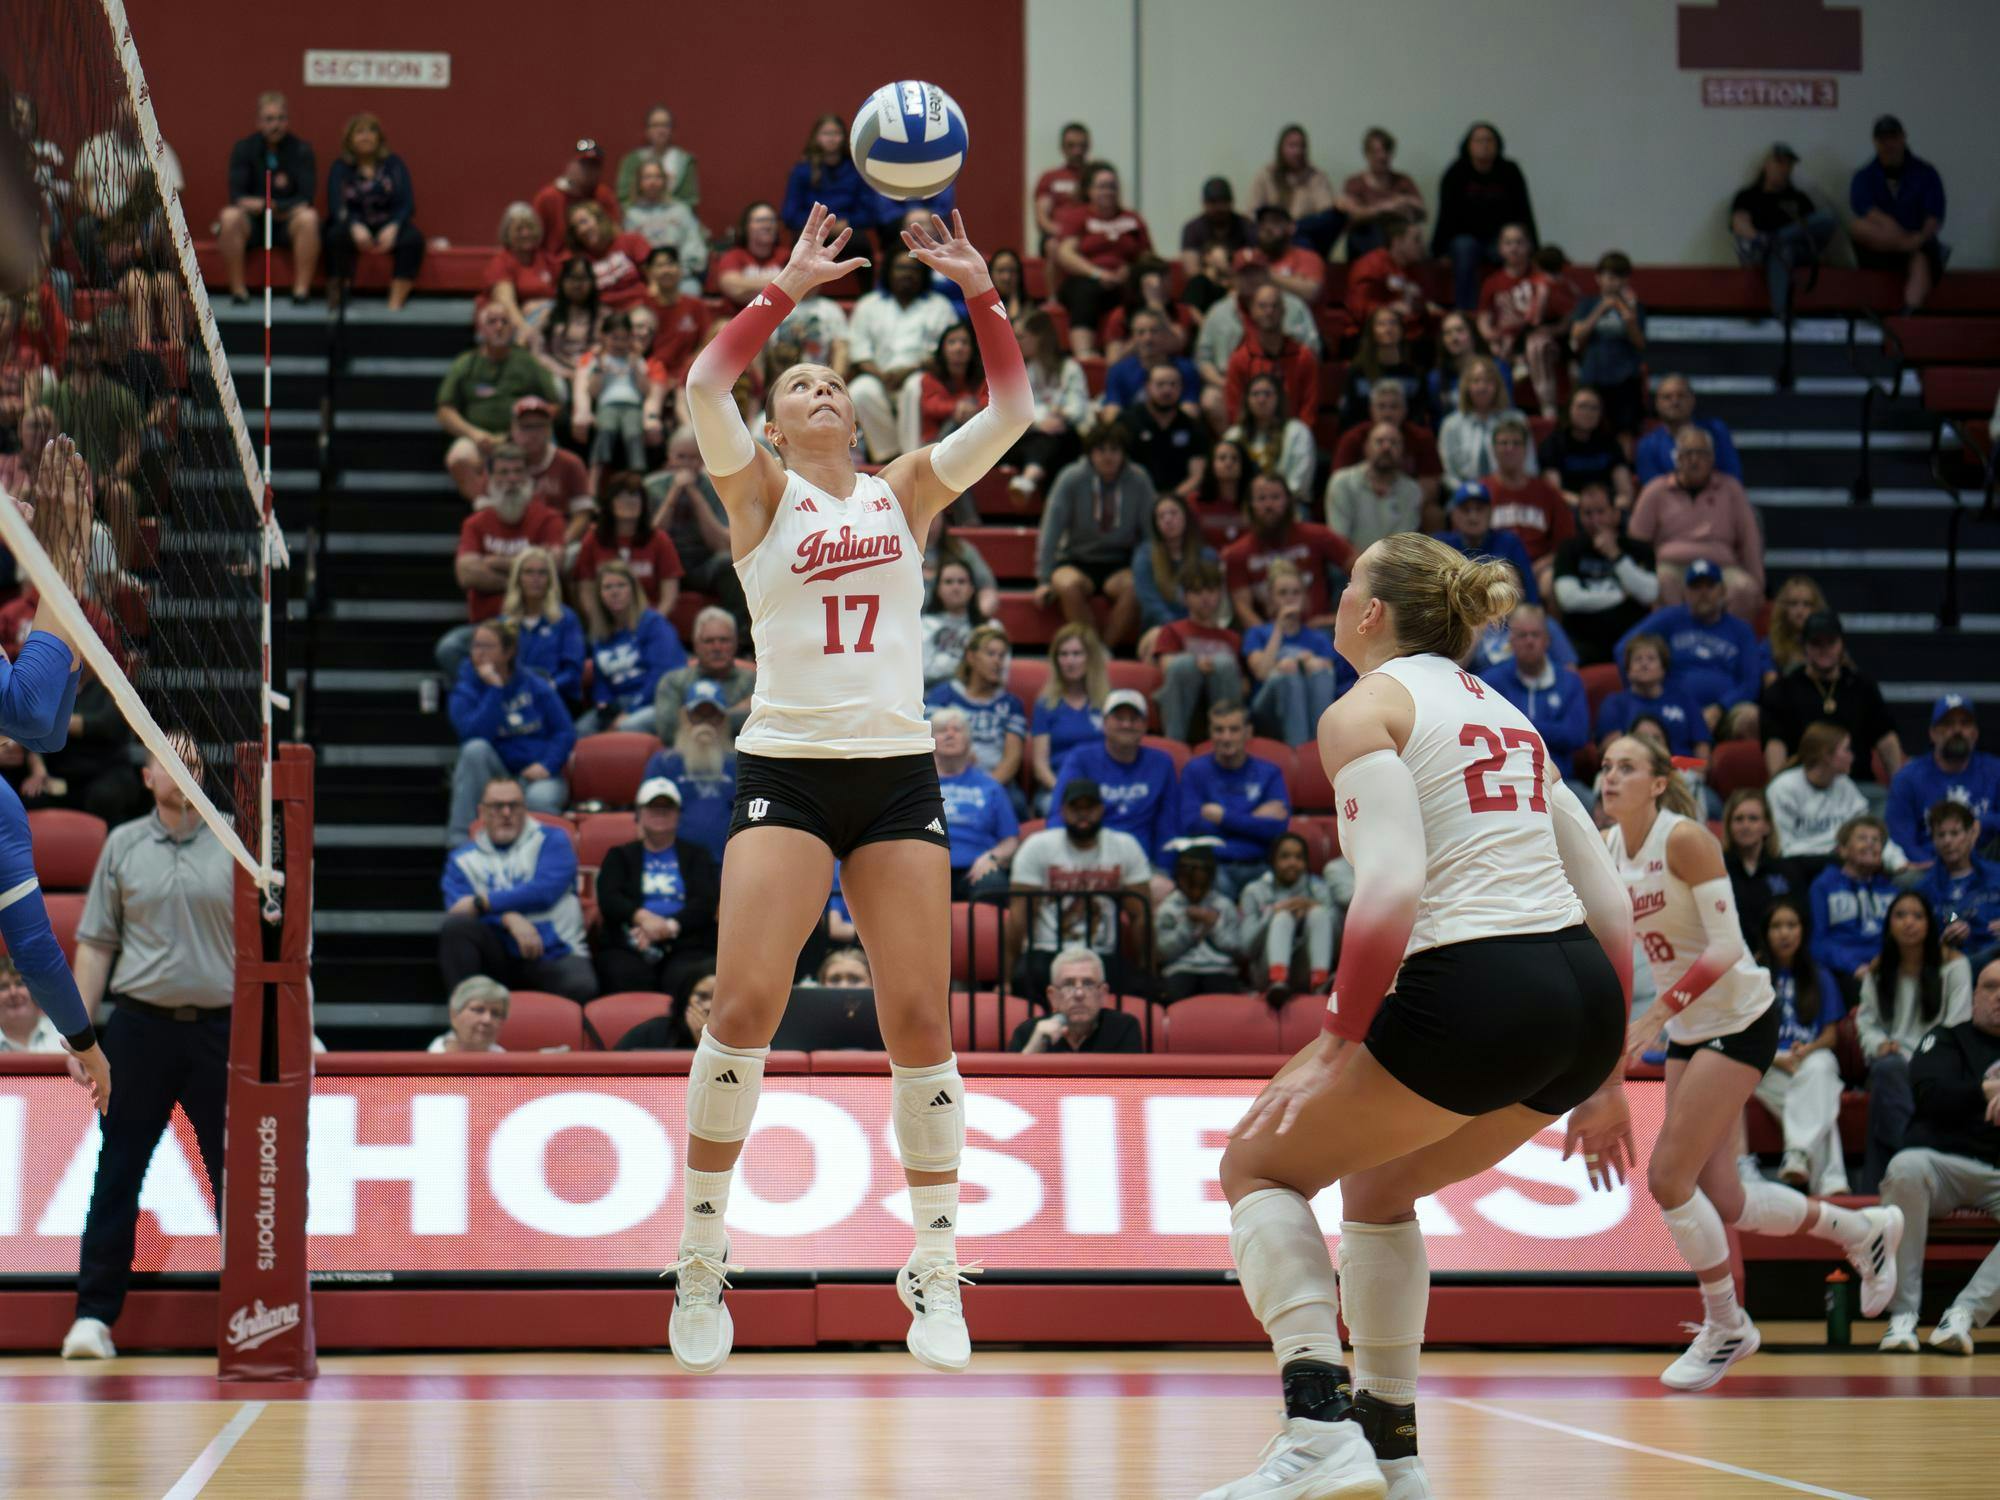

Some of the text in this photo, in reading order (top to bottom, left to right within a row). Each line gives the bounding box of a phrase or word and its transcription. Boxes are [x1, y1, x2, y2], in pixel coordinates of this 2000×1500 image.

[312, 59, 421, 79] SECTION
[1706, 81, 1815, 106] SECTION
[791, 525, 902, 575] Indiana
[822, 595, 880, 655] 17
[1459, 723, 1547, 814] 27
[308, 1091, 1633, 1238] HOOSIES
[254, 1116, 278, 1270] sports imports
[226, 1299, 301, 1346] Indiana
